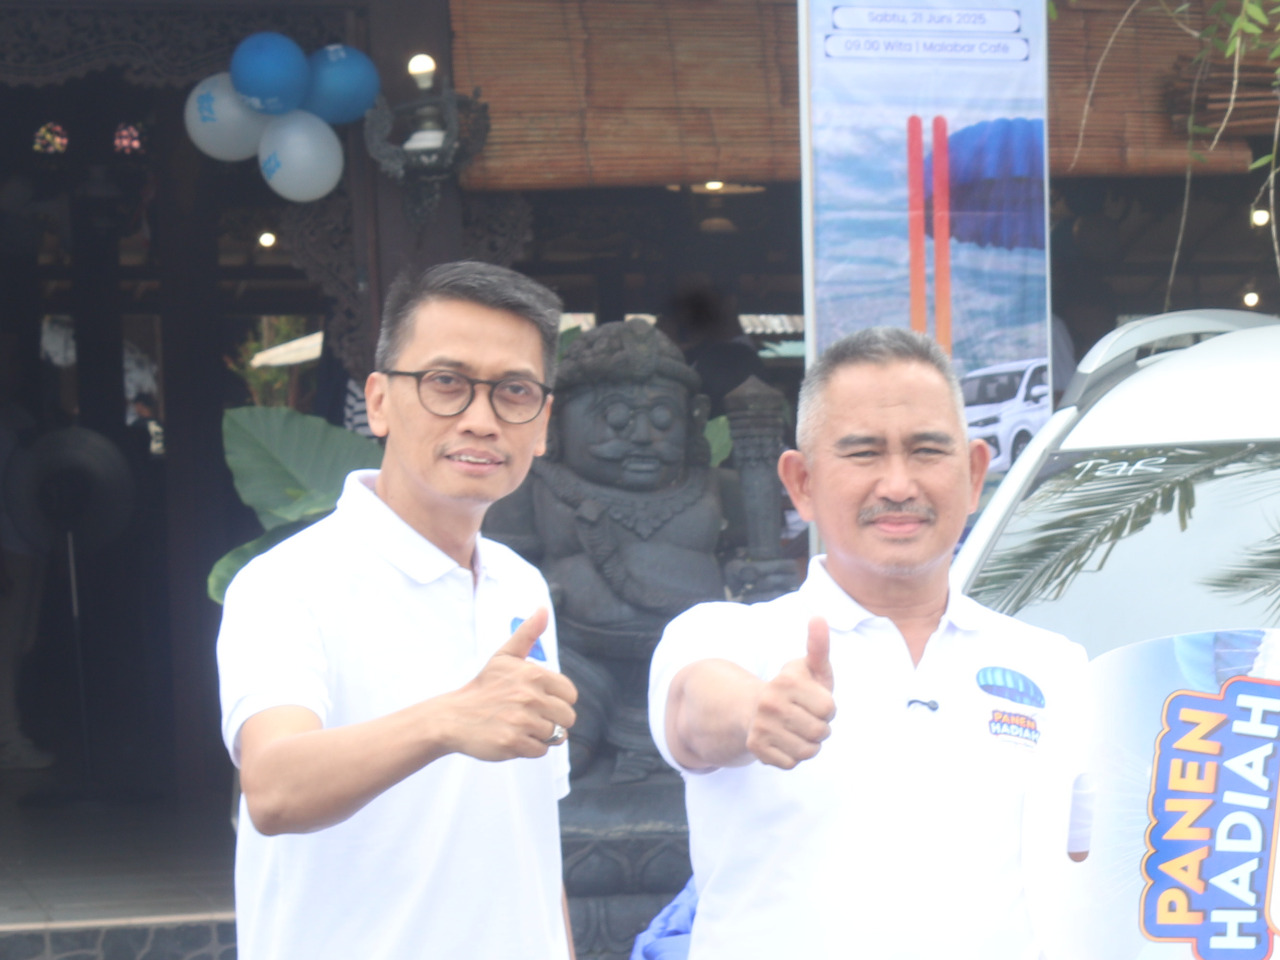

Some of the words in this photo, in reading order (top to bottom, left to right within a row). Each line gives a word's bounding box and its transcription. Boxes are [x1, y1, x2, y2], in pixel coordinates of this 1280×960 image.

[926, 12, 952, 25] Juni
[955, 13, 987, 25] 2025
[883, 40, 913, 52] Wita
[922, 41, 975, 54] Malabar
[1155, 706, 1229, 926] PANEN
